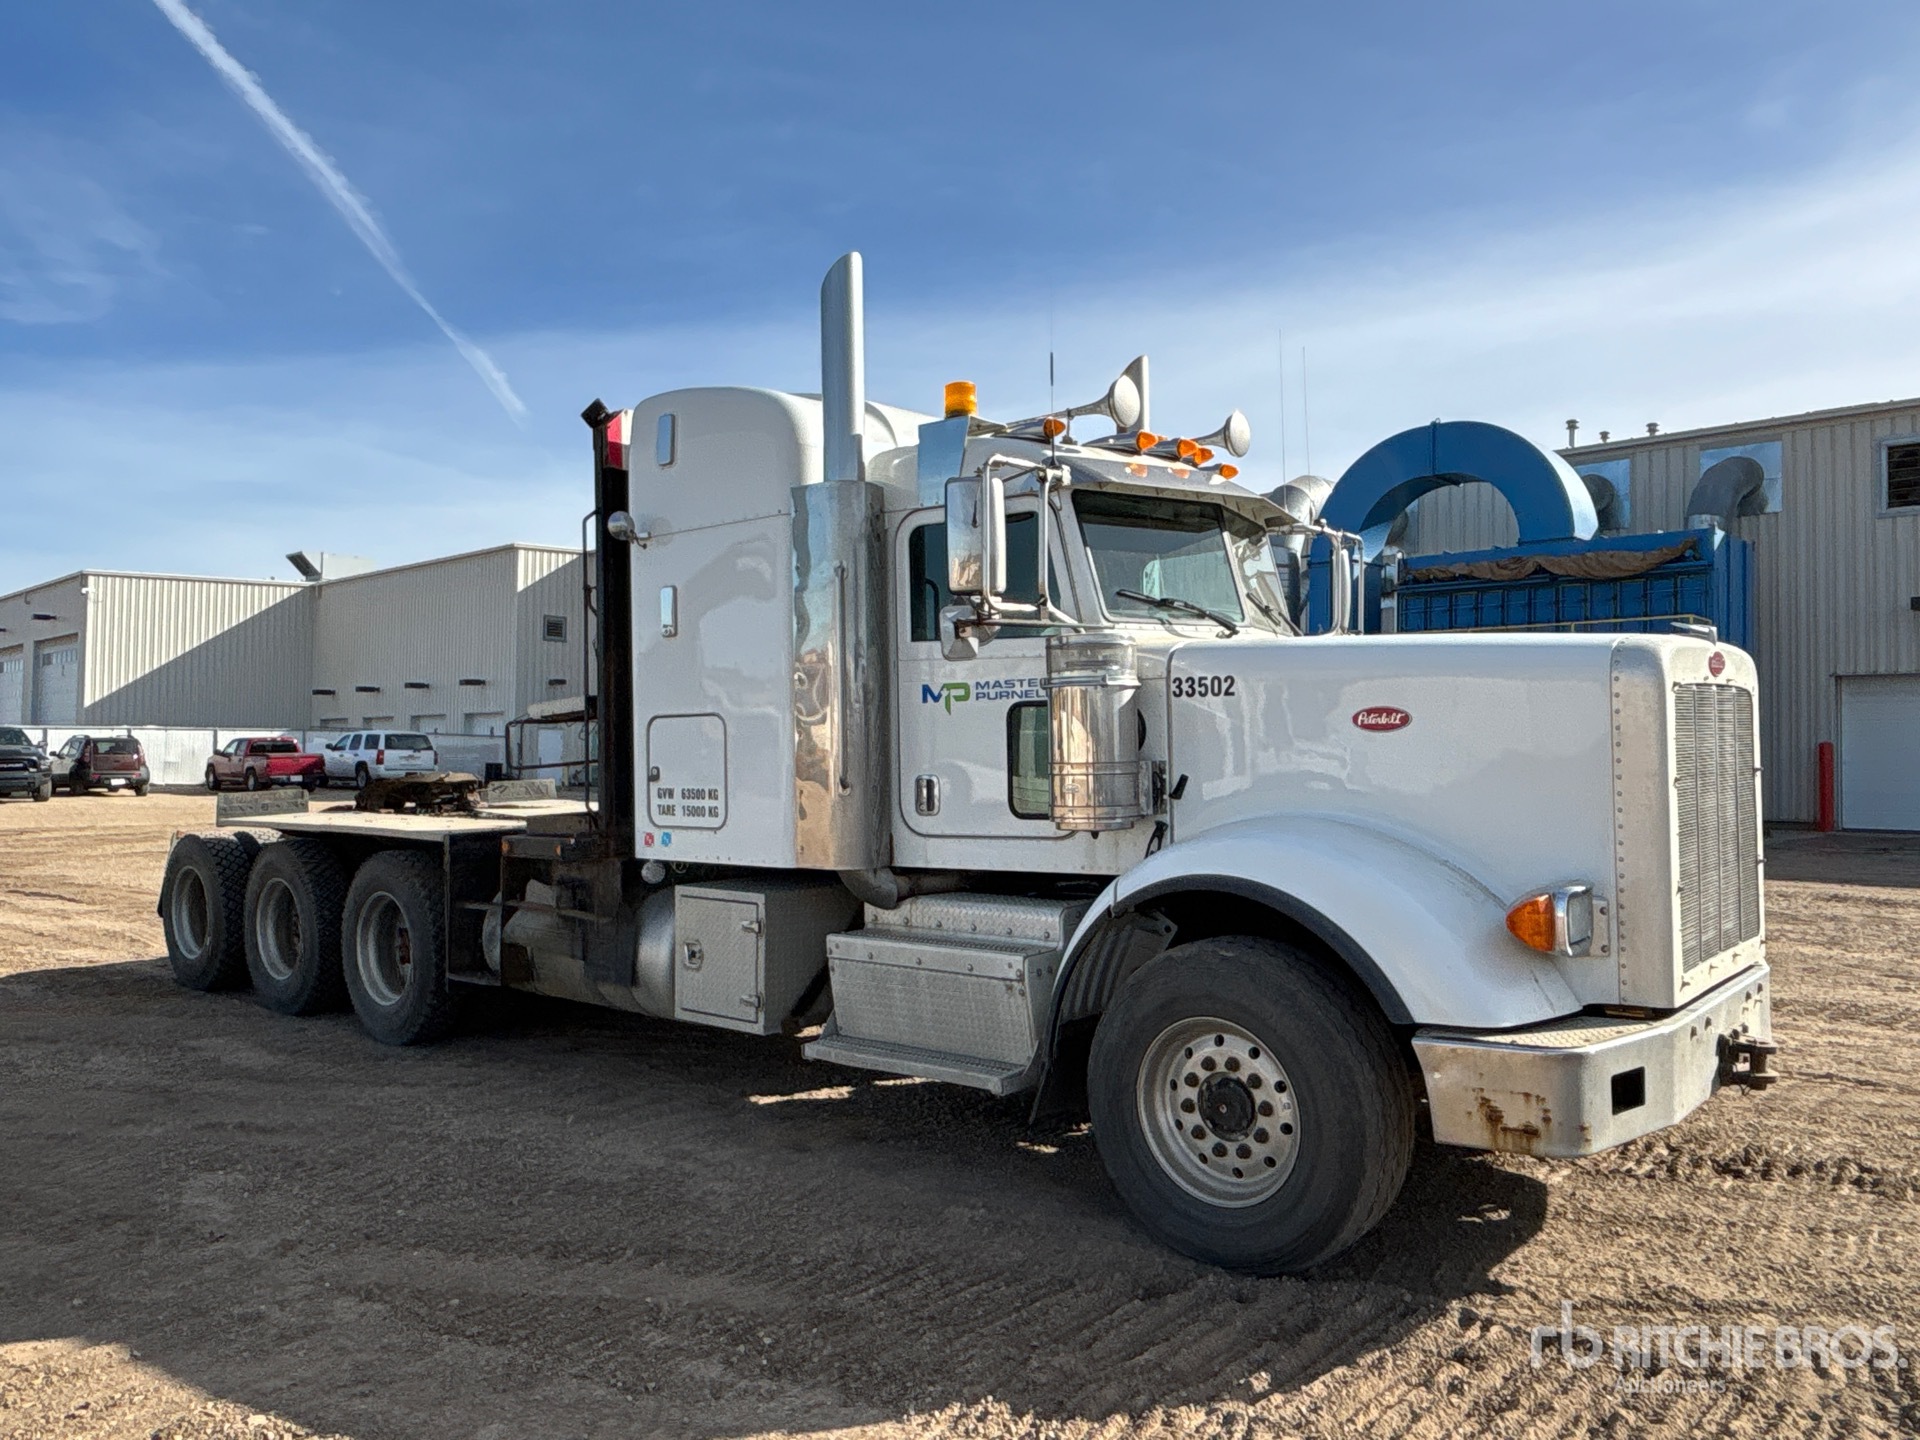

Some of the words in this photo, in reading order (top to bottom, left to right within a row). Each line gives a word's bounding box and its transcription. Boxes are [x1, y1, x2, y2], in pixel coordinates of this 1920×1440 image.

[975, 678, 1040, 690] MASTE
[1172, 675, 1235, 698] 33502
[1357, 711, 1406, 726] Peterbilt
[657, 787, 675, 799] GVW
[681, 788, 706, 800] 63500
[708, 788, 719, 800] KG
[657, 804, 676, 816] TARE
[681, 805, 706, 817] 15000
[708, 806, 719, 818] KG
